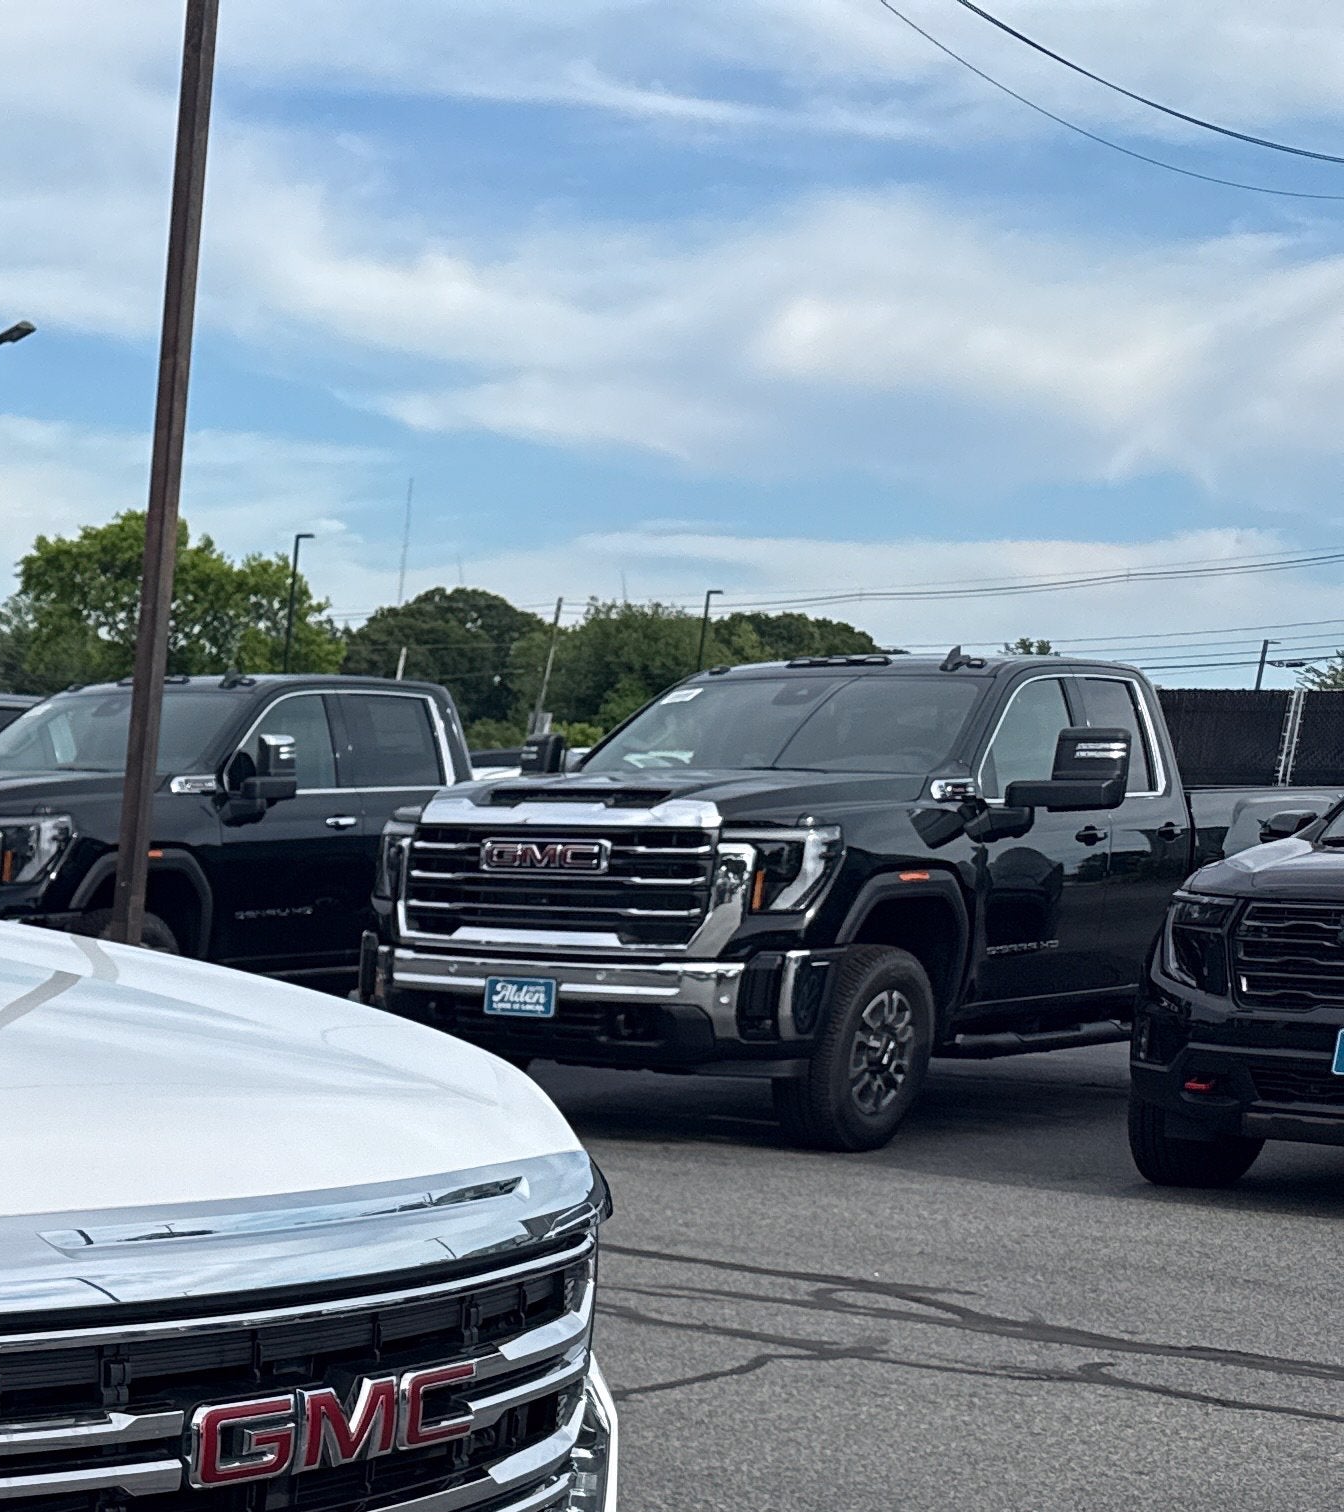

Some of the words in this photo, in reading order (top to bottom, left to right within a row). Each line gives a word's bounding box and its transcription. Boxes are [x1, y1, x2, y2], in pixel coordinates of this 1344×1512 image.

[485, 843, 600, 868] GMC
[492, 982, 545, 1003] Alden
[189, 1361, 477, 1489] GMC
